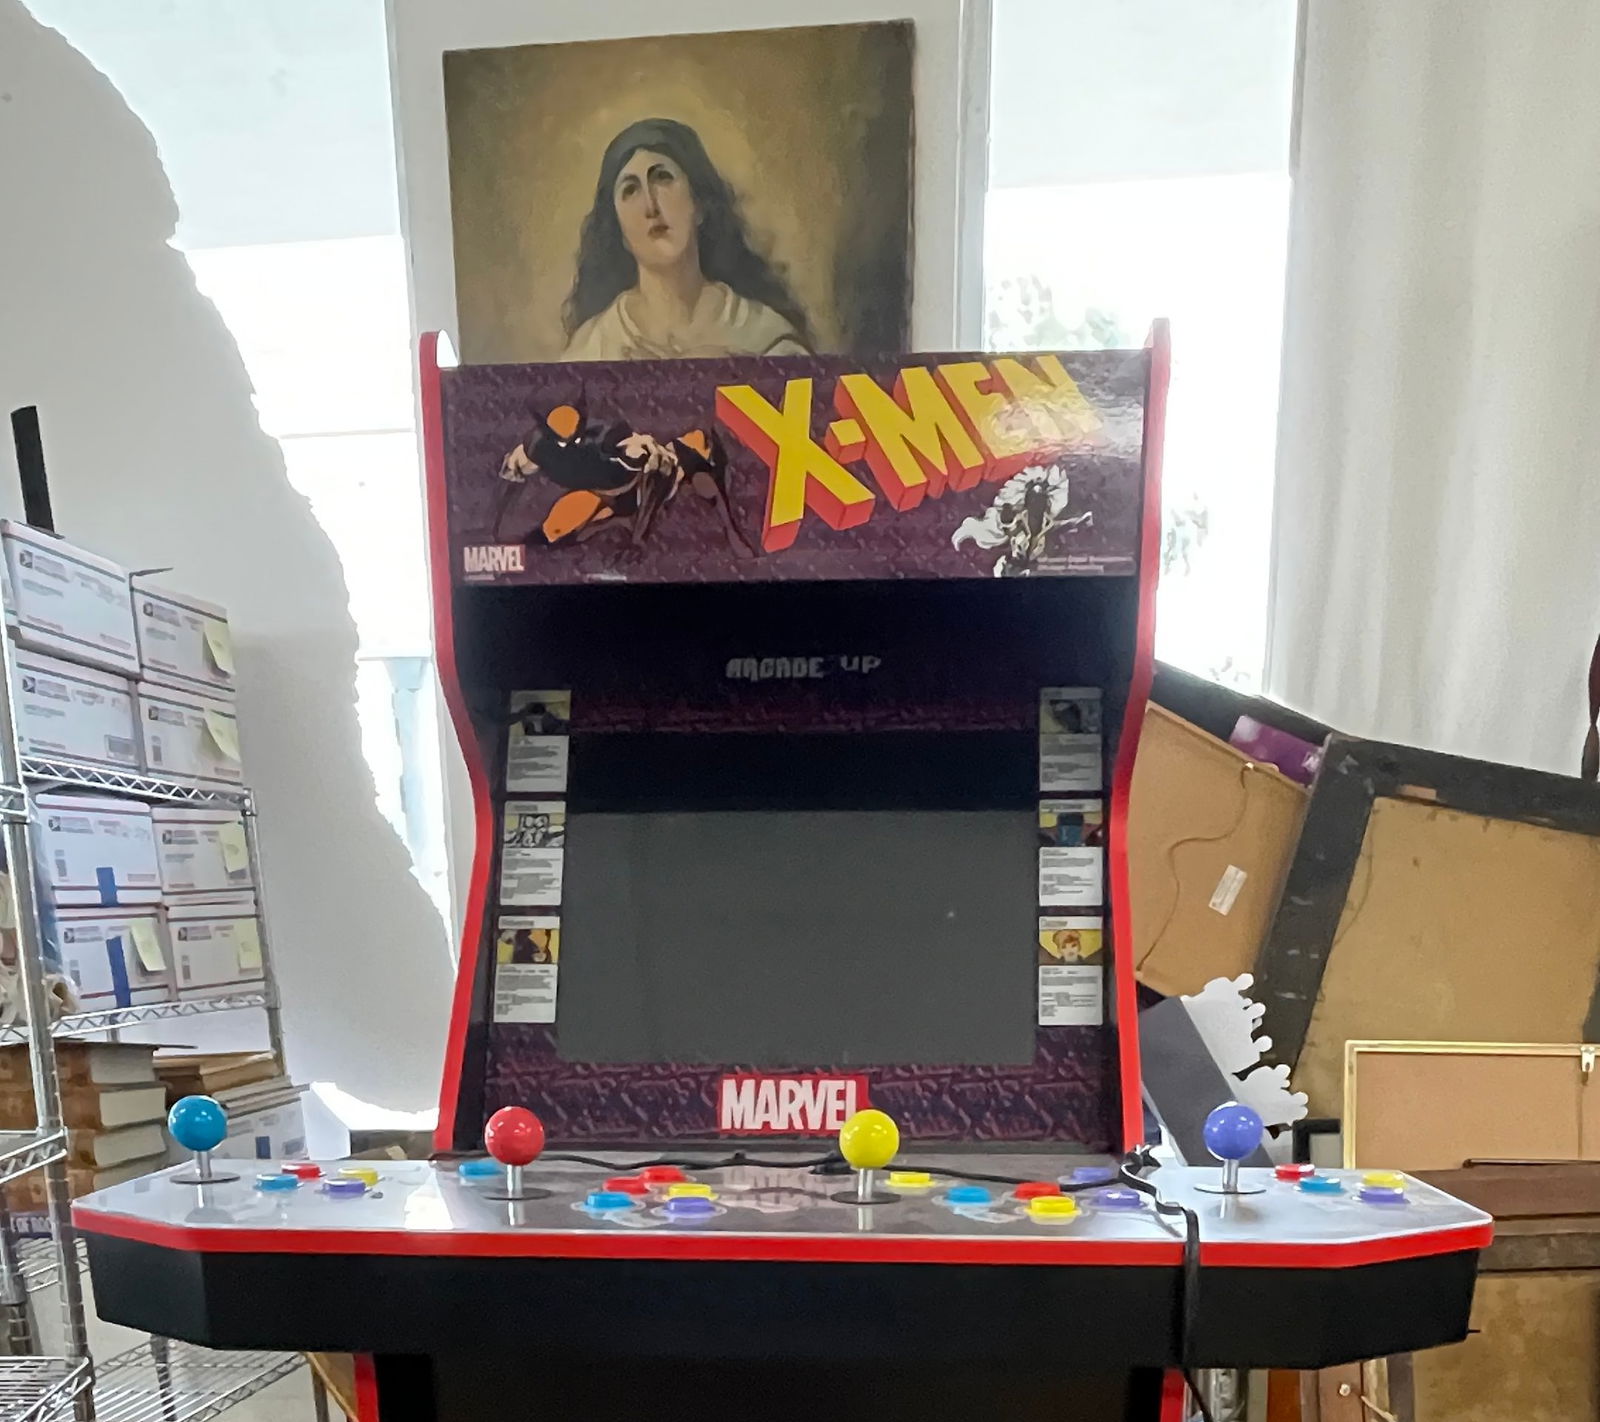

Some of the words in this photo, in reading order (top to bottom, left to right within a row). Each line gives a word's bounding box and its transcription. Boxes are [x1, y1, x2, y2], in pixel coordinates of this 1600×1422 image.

[716, 355, 1102, 553] X-MEN
[464, 545, 525, 572] MARVEL
[725, 657, 825, 682] ARCADE
[840, 655, 882, 675] UP
[721, 1079, 857, 1131] MARVEL
